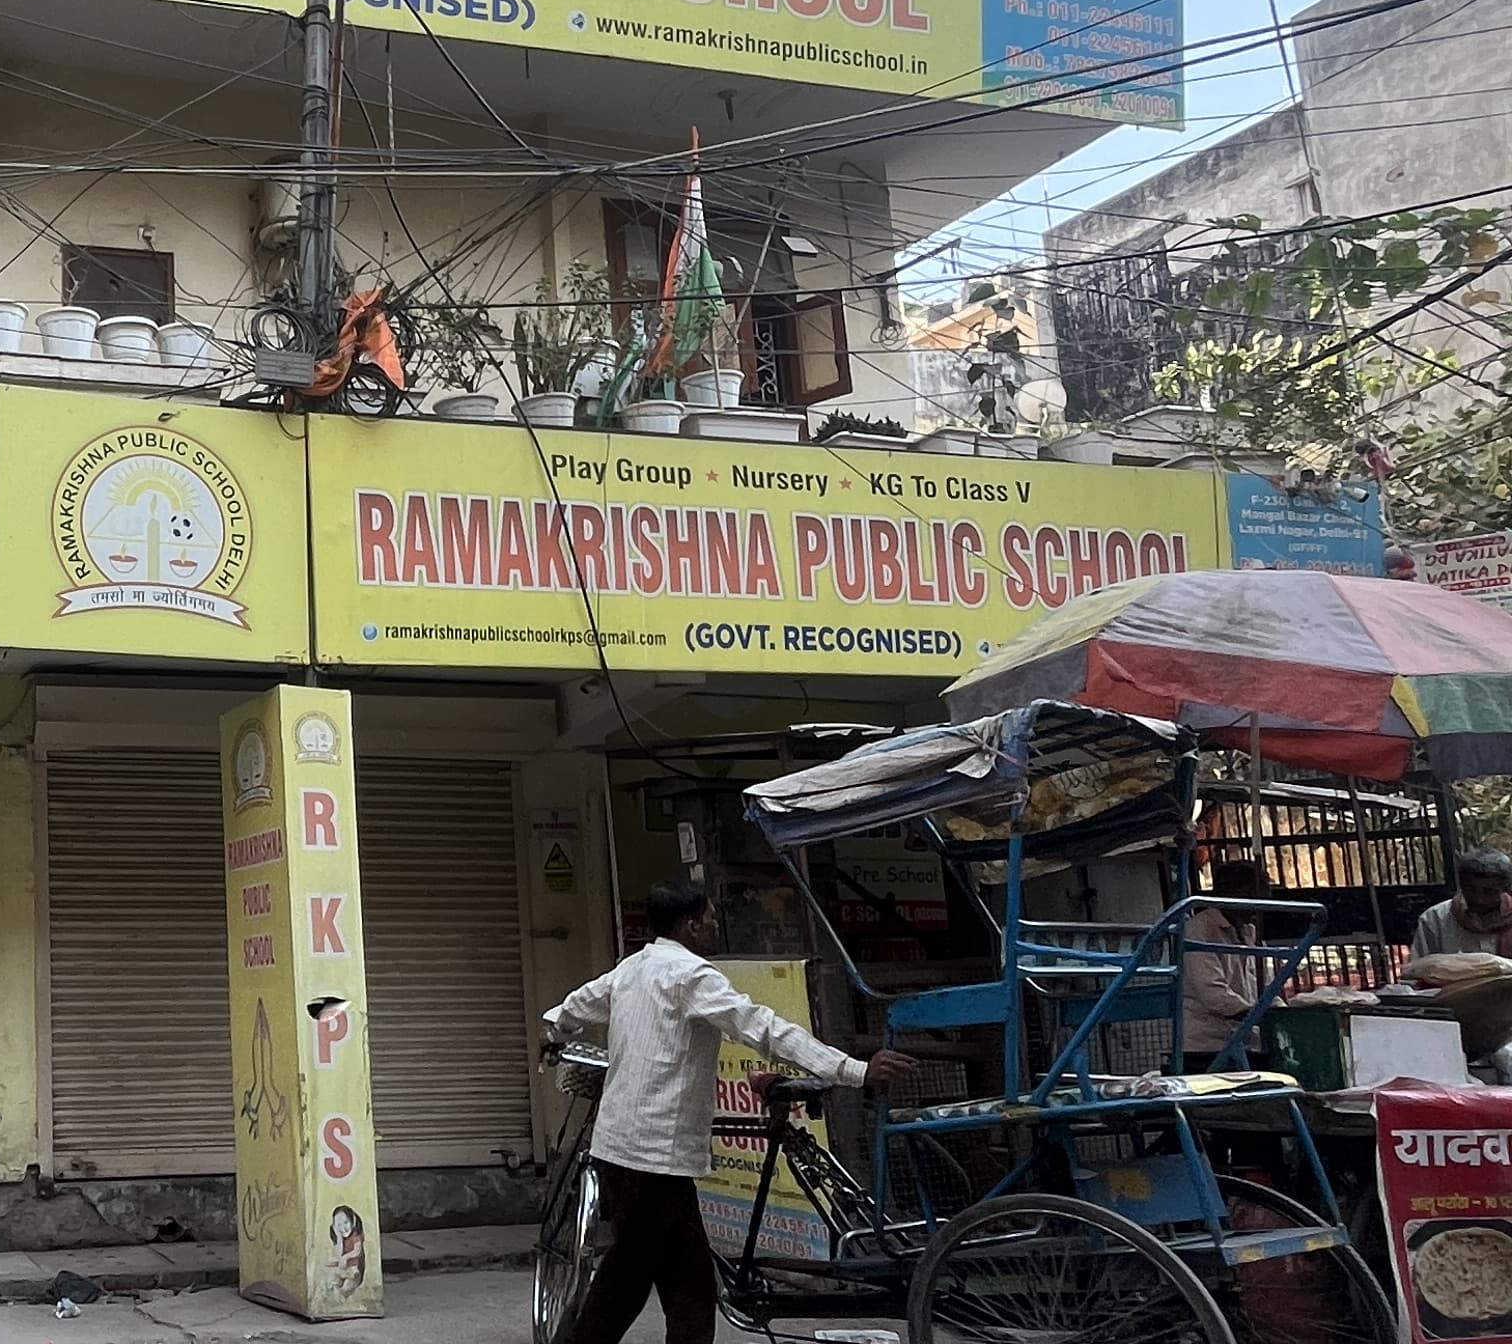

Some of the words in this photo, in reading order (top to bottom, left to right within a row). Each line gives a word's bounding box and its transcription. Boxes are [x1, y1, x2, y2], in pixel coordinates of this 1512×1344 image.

[596, 17, 927, 75] www.ramakrishnapublicschool.in
[117, 432, 189, 456] PUBLIC
[193, 451, 244, 527] SCHOOL
[551, 454, 607, 485] Play
[616, 458, 691, 489] Group
[732, 465, 829, 498] Nursery
[870, 473, 903, 497] KG
[911, 475, 937, 498] To
[946, 477, 1008, 502] Class
[1015, 481, 1031, 503] V
[60, 442, 116, 580] RAMAKRISHNA
[215, 533, 245, 590] DELHI
[354, 488, 784, 600] RAMAKRISHNA
[792, 512, 987, 609] PUBLIC
[132, 591, 144, 603] मा
[685, 622, 776, 652] (GOVT.
[784, 624, 963, 658] RECOGNISED)
[887, 866, 938, 883] School
